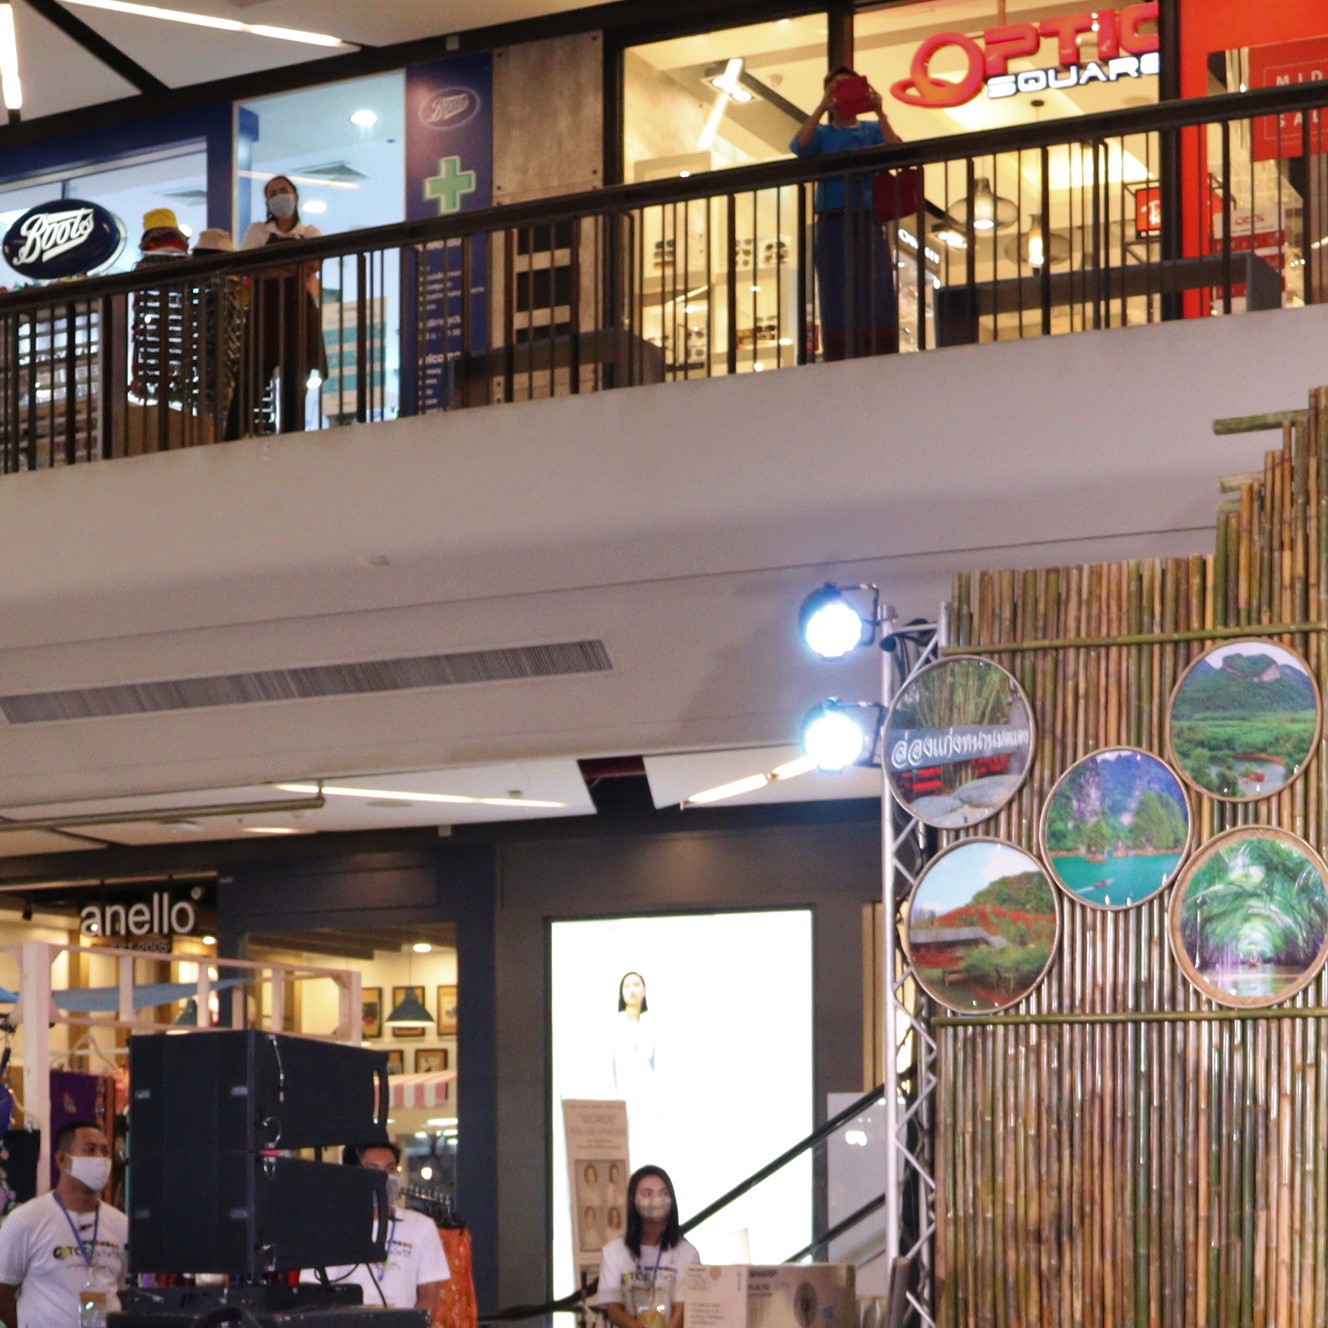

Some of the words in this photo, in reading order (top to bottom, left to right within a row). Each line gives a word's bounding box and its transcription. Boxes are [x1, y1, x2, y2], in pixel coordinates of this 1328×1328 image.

[889, 2, 1159, 109] OPTIC
[986, 52, 1160, 99] SQUARE
[12, 208, 95, 266] Boots
[80, 891, 195, 936] anello
